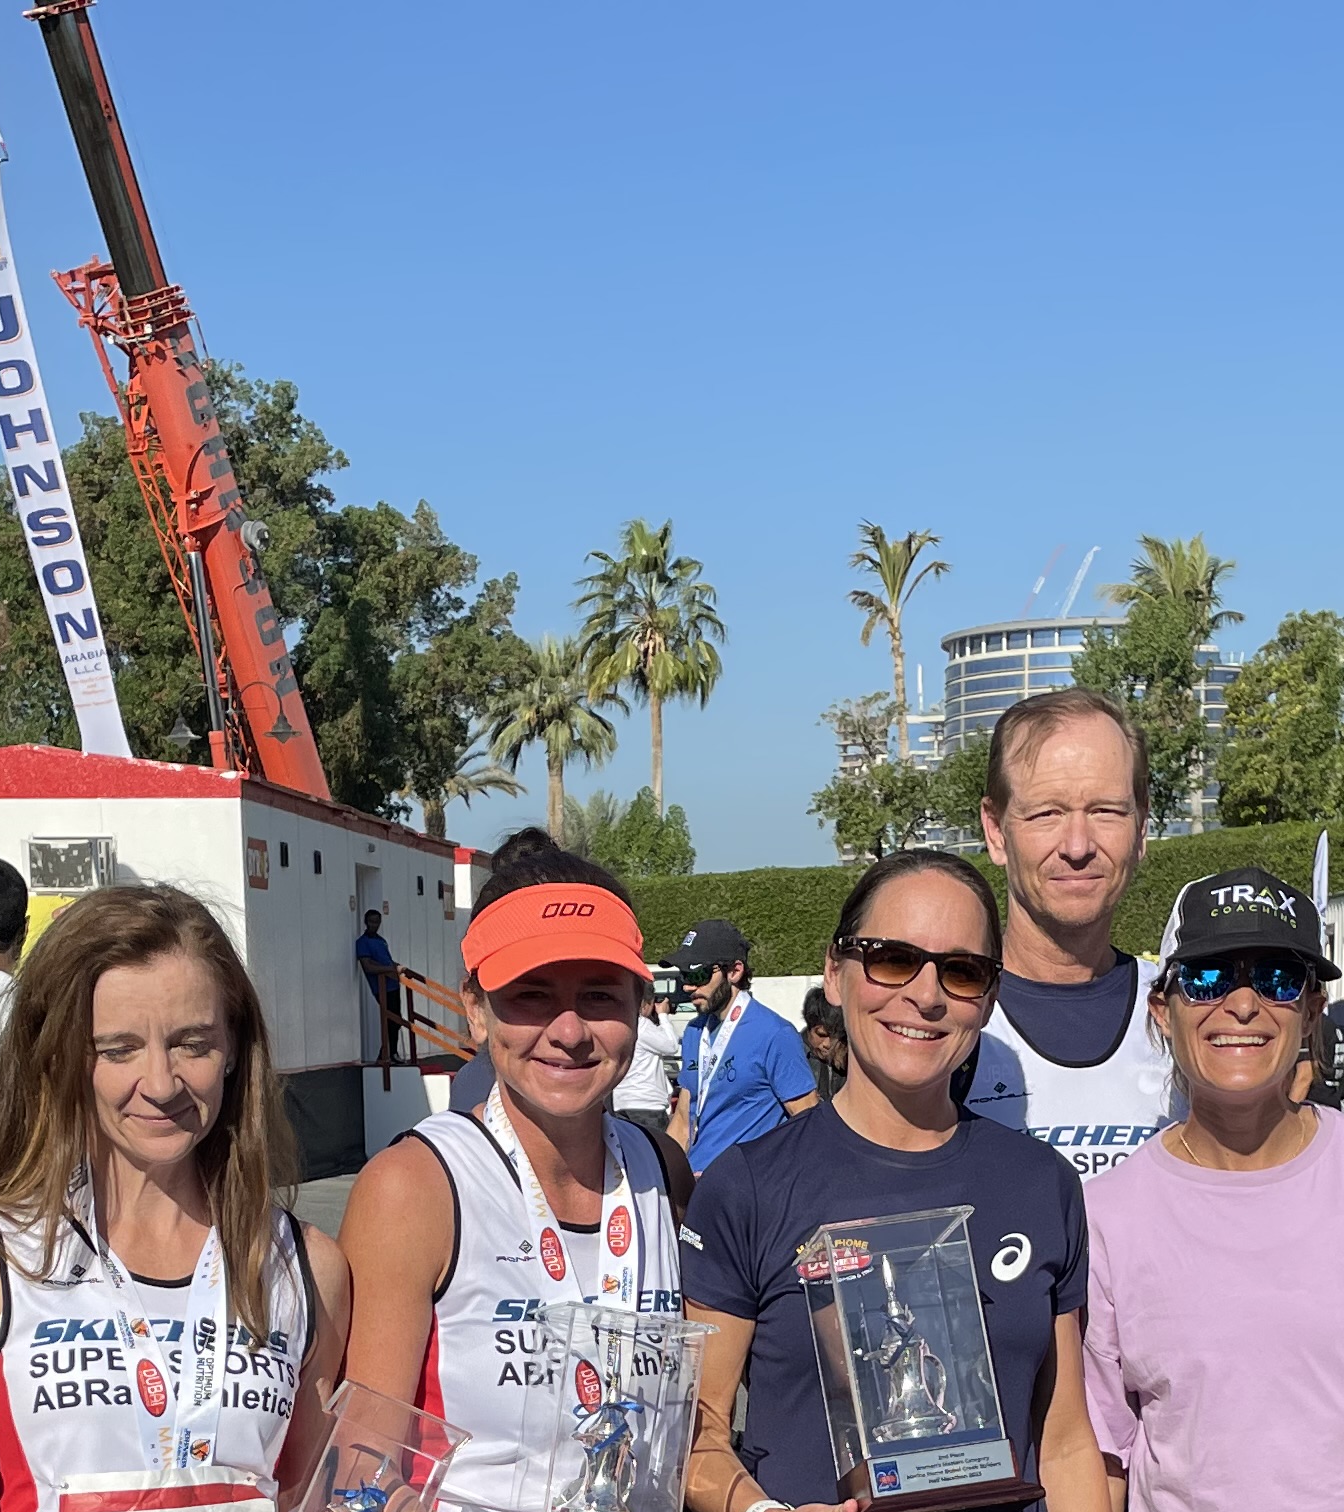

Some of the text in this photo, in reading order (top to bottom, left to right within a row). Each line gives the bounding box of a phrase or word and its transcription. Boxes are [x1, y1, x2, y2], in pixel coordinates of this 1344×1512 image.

[64, 648, 106, 664] ARABIA
[1210, 884, 1297, 919] TRAX
[1210, 903, 1298, 930] COACHING
[609, 1213, 627, 1248] DUBAI
[542, 1236, 561, 1272] DUBAI
[29, 1345, 127, 1379] SUPE
[205, 1358, 215, 1400] OPTIMUM
[32, 1377, 133, 1413] ABRa
[142, 1368, 164, 1407] DUBAI
[193, 1357, 205, 1407] NUTRITION
